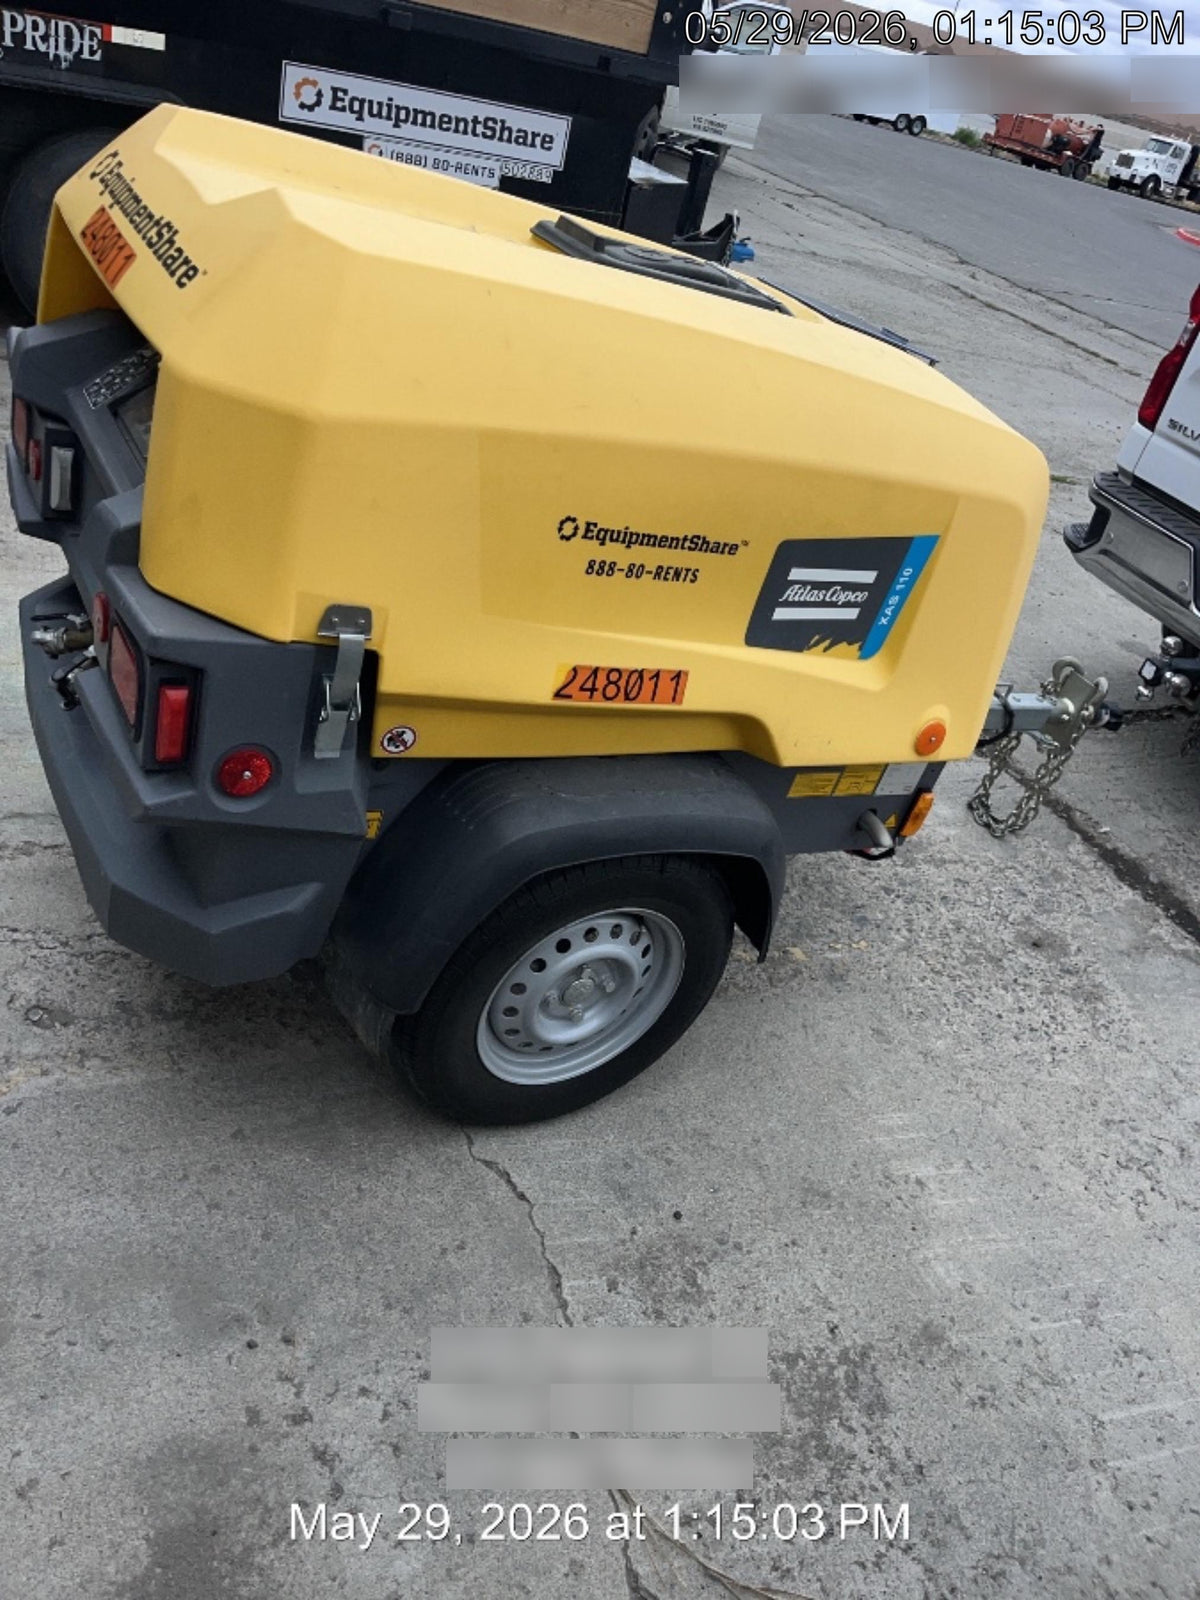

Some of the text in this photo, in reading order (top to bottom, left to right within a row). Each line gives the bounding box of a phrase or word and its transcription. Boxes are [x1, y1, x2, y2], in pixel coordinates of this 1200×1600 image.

[2, 10, 102, 61] PRIDE
[328, 86, 555, 151] EquipmentShare
[432, 158, 496, 179] 80-RENTS
[99, 160, 199, 289] EquipmentShare
[581, 521, 740, 556] EquipmentShare
[585, 559, 700, 584] 888-80-RENTS
[779, 584, 869, 605] Atlas Copco
[878, 568, 913, 625] XAS 110
[553, 666, 682, 702] 248011
